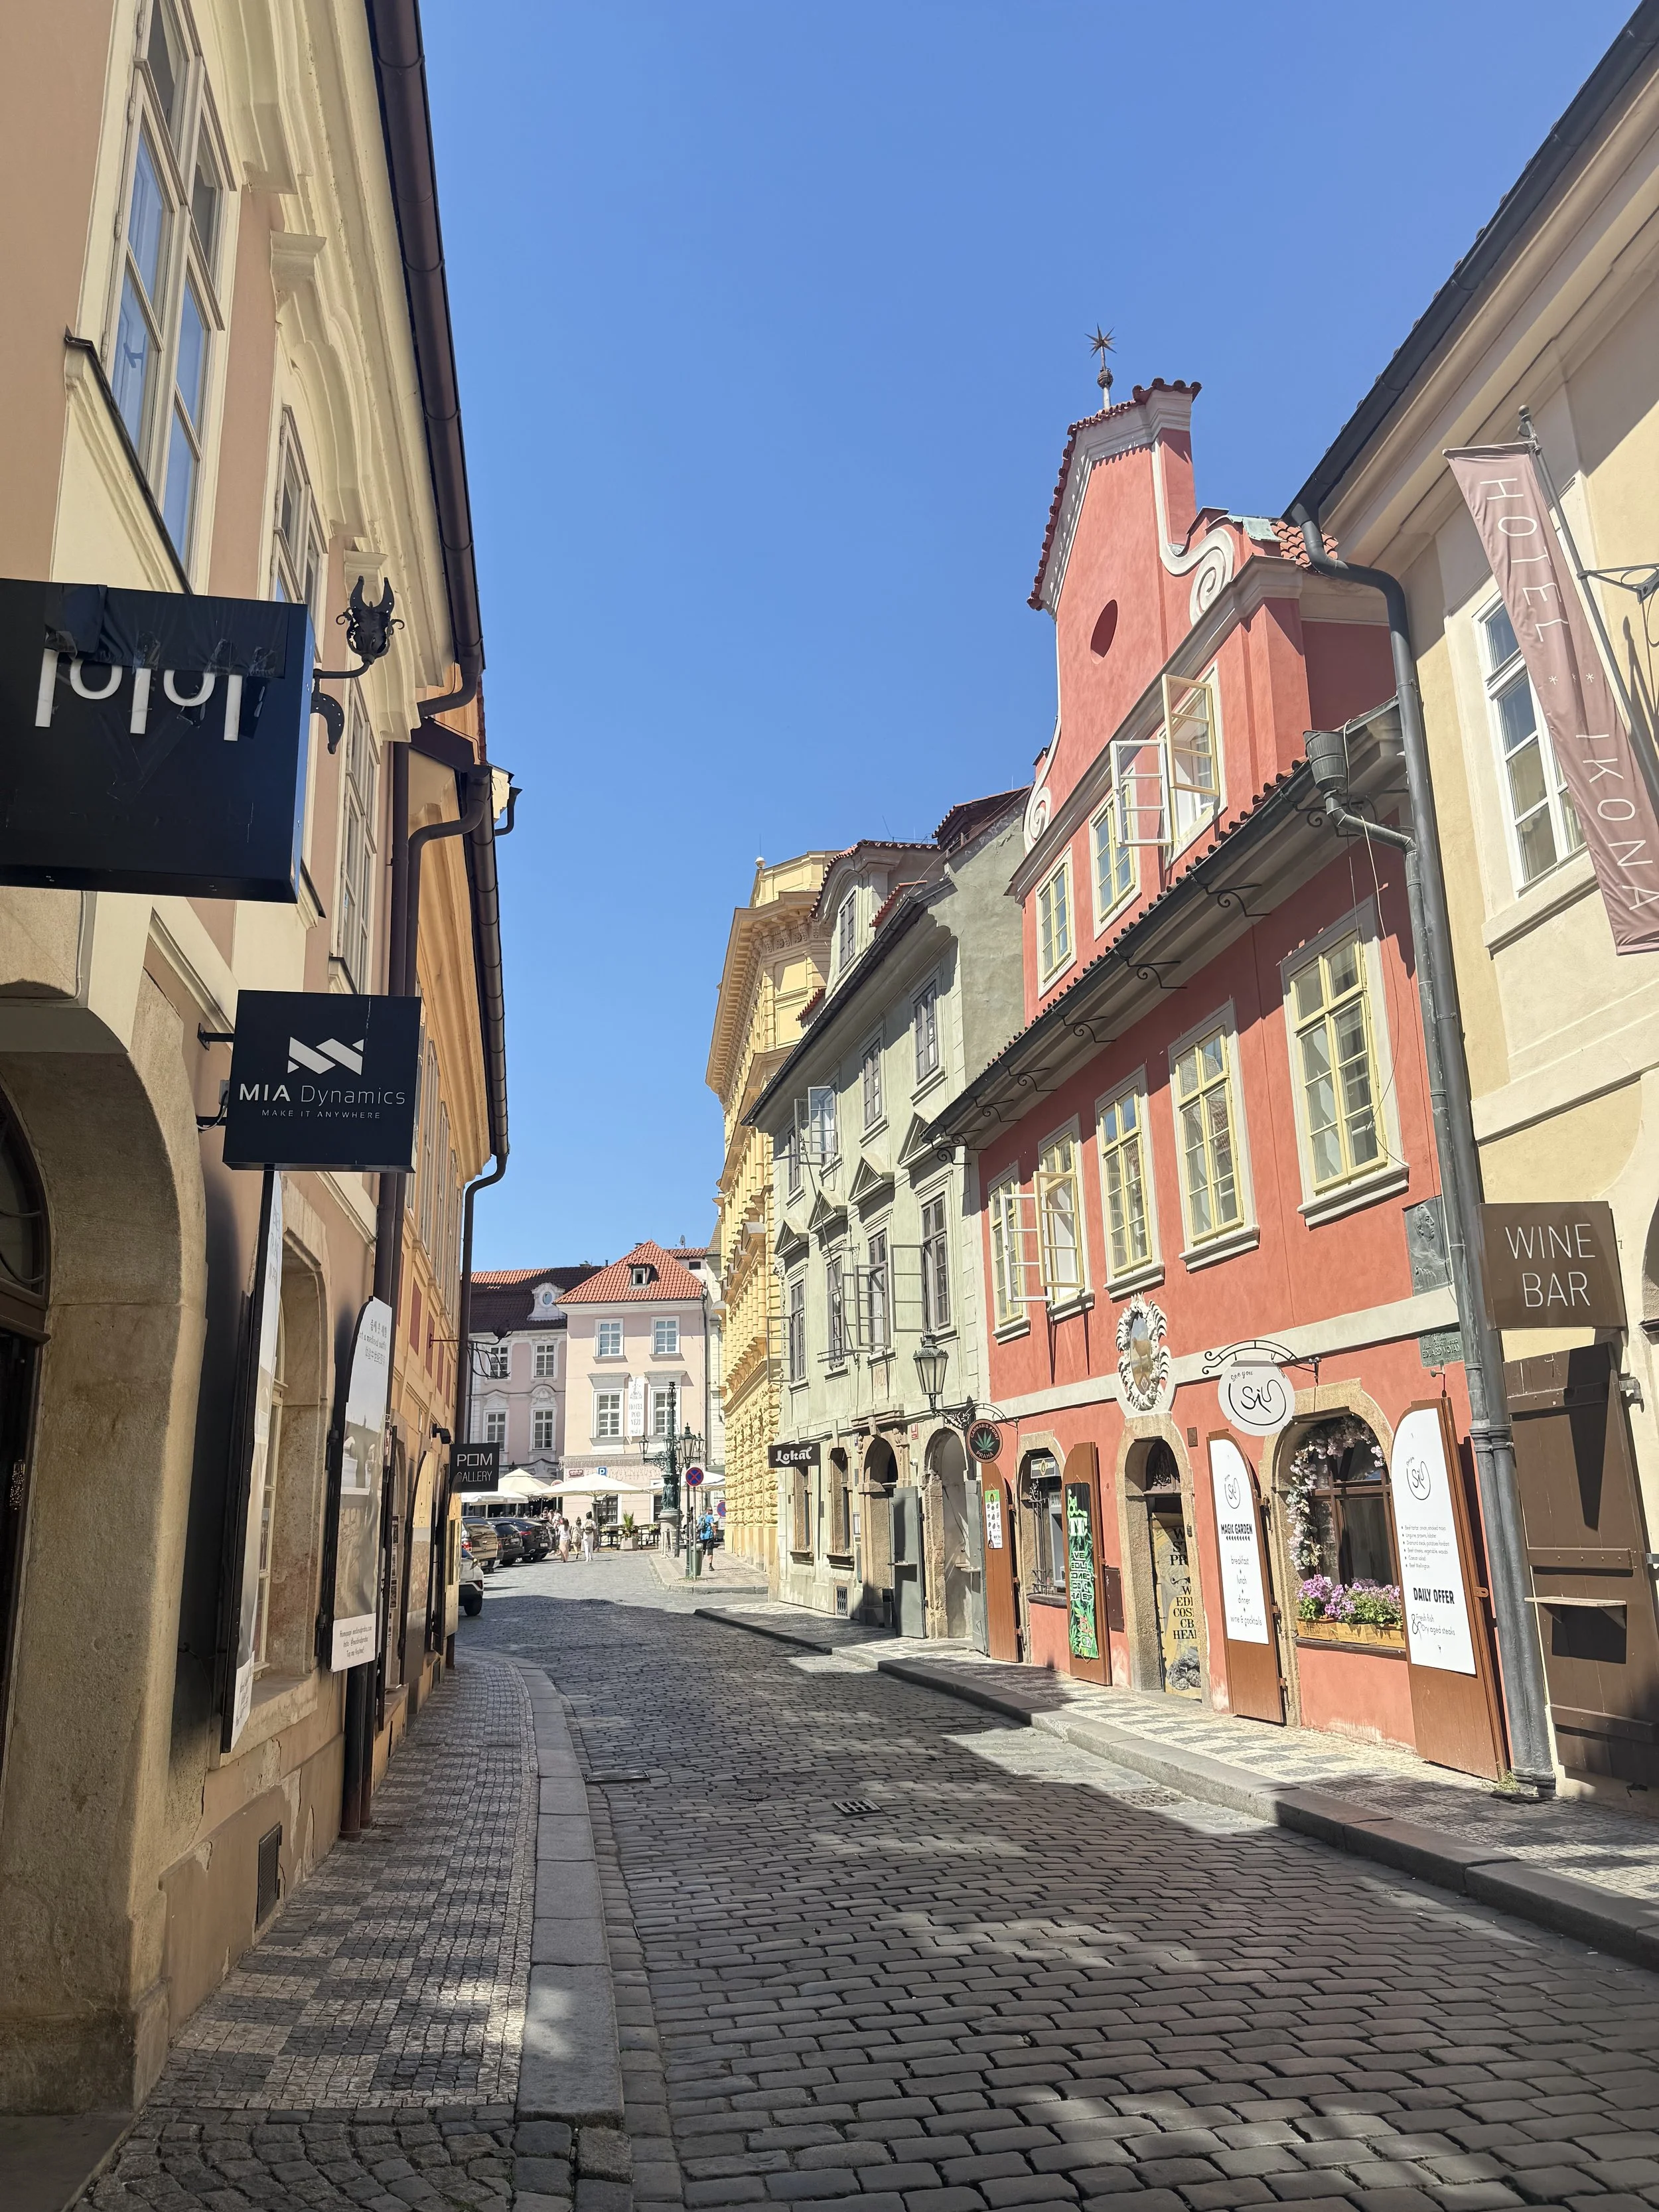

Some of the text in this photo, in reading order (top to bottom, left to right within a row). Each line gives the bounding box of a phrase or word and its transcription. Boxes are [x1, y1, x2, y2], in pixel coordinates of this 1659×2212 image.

[1480, 477, 1569, 643] HOTEL
[1575, 733, 1659, 911] IKONA
[239, 1083, 405, 1106] MIA Dynamics
[1505, 1224, 1595, 1259] WINE
[1522, 1272, 1591, 1307] BAR
[1230, 1370, 1254, 1382] See you
[970, 1423, 989, 1438] CANNABIS
[989, 1426, 999, 1440] POINT
[775, 1445, 812, 1465] Lokal
[976, 1450, 994, 1459] PRAHA
[1221, 1523, 1253, 1534] MAGIC GARDEN
[1231, 1555, 1249, 1565] breakfast
[1237, 1574, 1248, 1585] lunch
[1238, 1594, 1250, 1605] dinner
[1413, 1587, 1455, 1604] DAILY OFFER
[1429, 1625, 1441, 1635] aged
[1442, 1626, 1455, 1636] steaks
